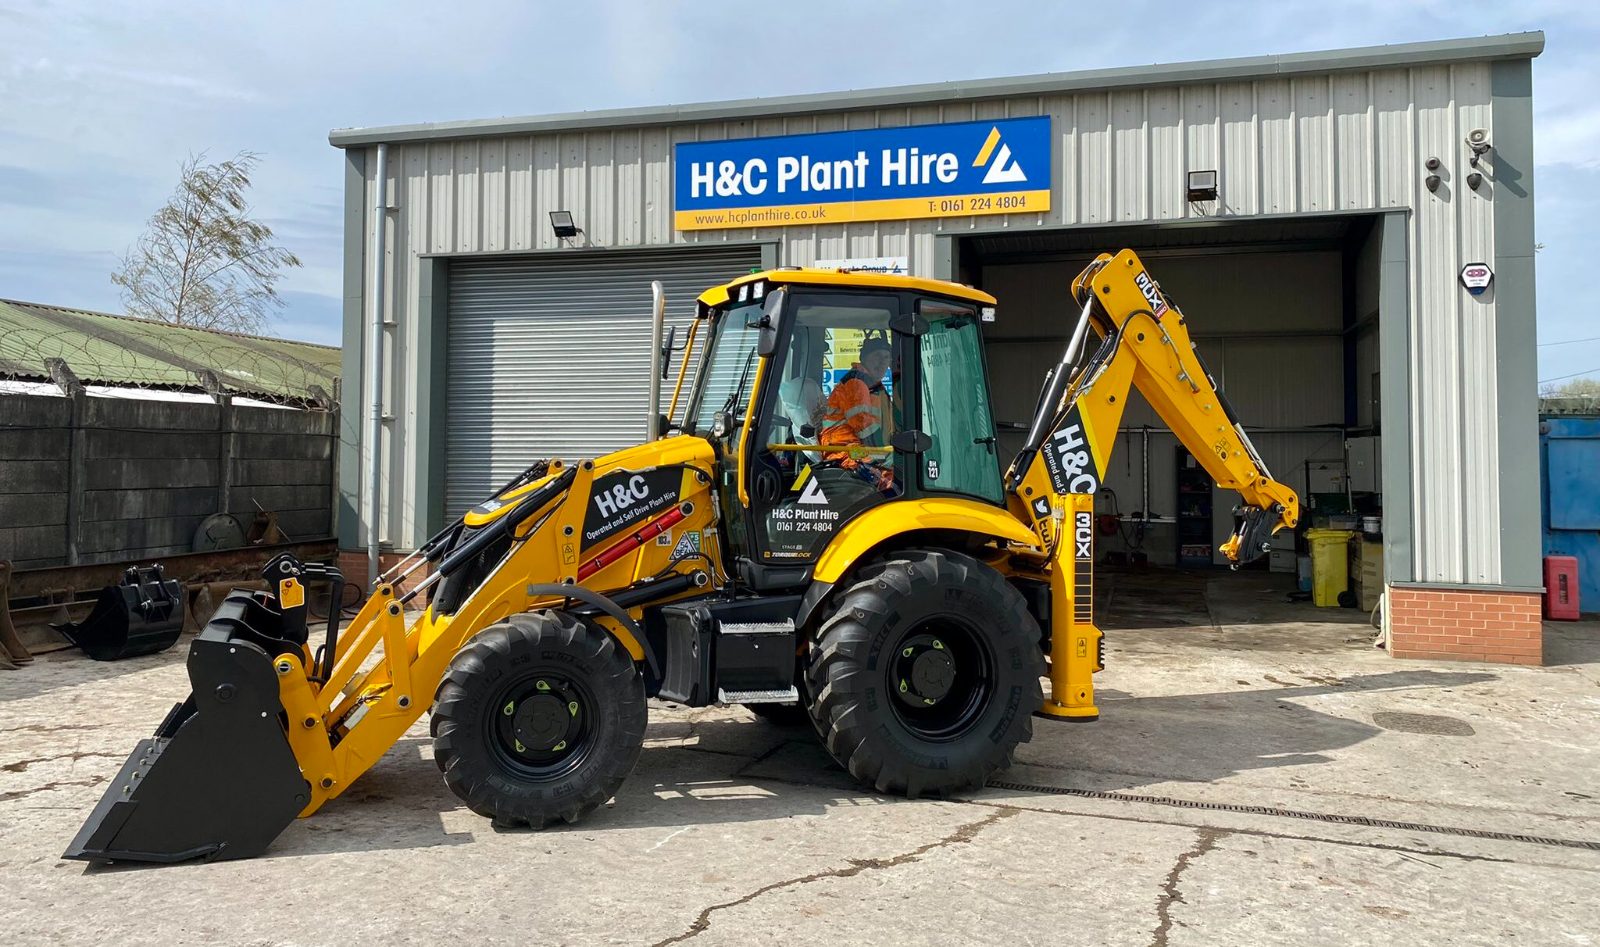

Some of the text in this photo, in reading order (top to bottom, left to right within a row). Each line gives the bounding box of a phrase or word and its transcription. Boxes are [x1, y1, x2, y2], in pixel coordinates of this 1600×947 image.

[691, 147, 959, 198] H&C Plant Hire
[695, 205, 826, 225] www.hcplanthire.co.uk
[928, 196, 1026, 213] T: 0161 224 4804
[1136, 272, 1162, 310] 3CX
[928, 467, 938, 478] 121
[1044, 443, 1060, 475] Operated
[1054, 475, 1064, 488] and
[1053, 424, 1097, 494] H&C
[586, 491, 676, 540] Operated and Self Drive Plant Hire
[594, 475, 649, 518] H&C
[772, 508, 839, 520] H&C Plant Hire
[776, 521, 832, 531] 0161 224 4804
[1076, 512, 1091, 557] 3CX
